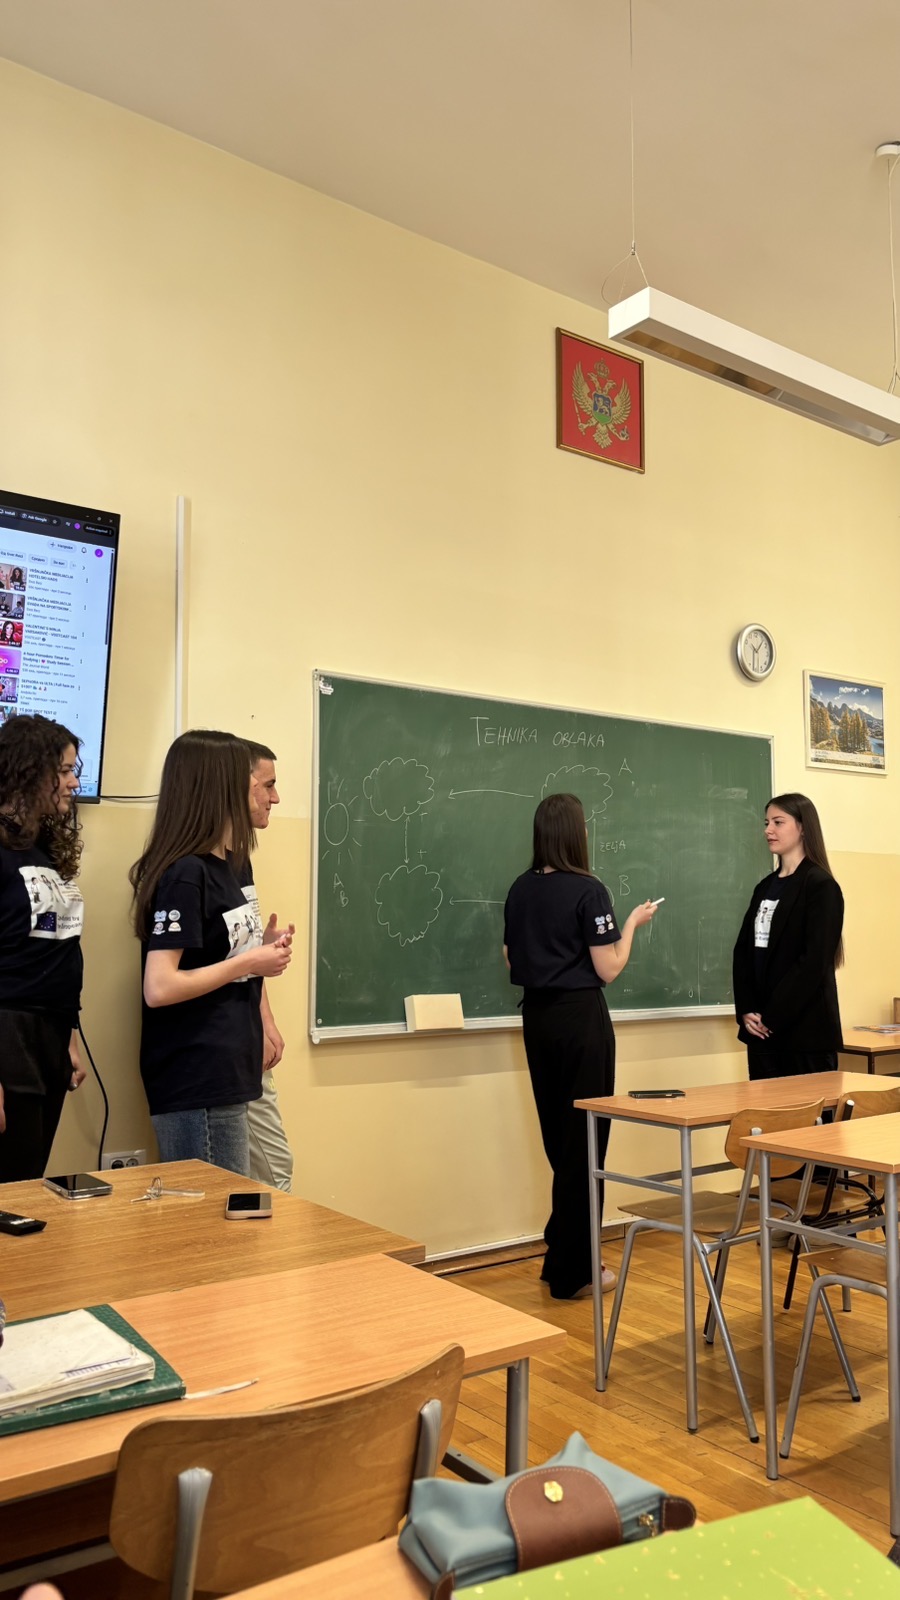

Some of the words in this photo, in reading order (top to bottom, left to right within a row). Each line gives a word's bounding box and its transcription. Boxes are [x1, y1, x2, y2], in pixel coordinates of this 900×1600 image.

[469, 716, 538, 746] TEHNIKA
[552, 731, 605, 747] OBLAKA
[618, 757, 632, 776] A
[619, 874, 631, 897] B
